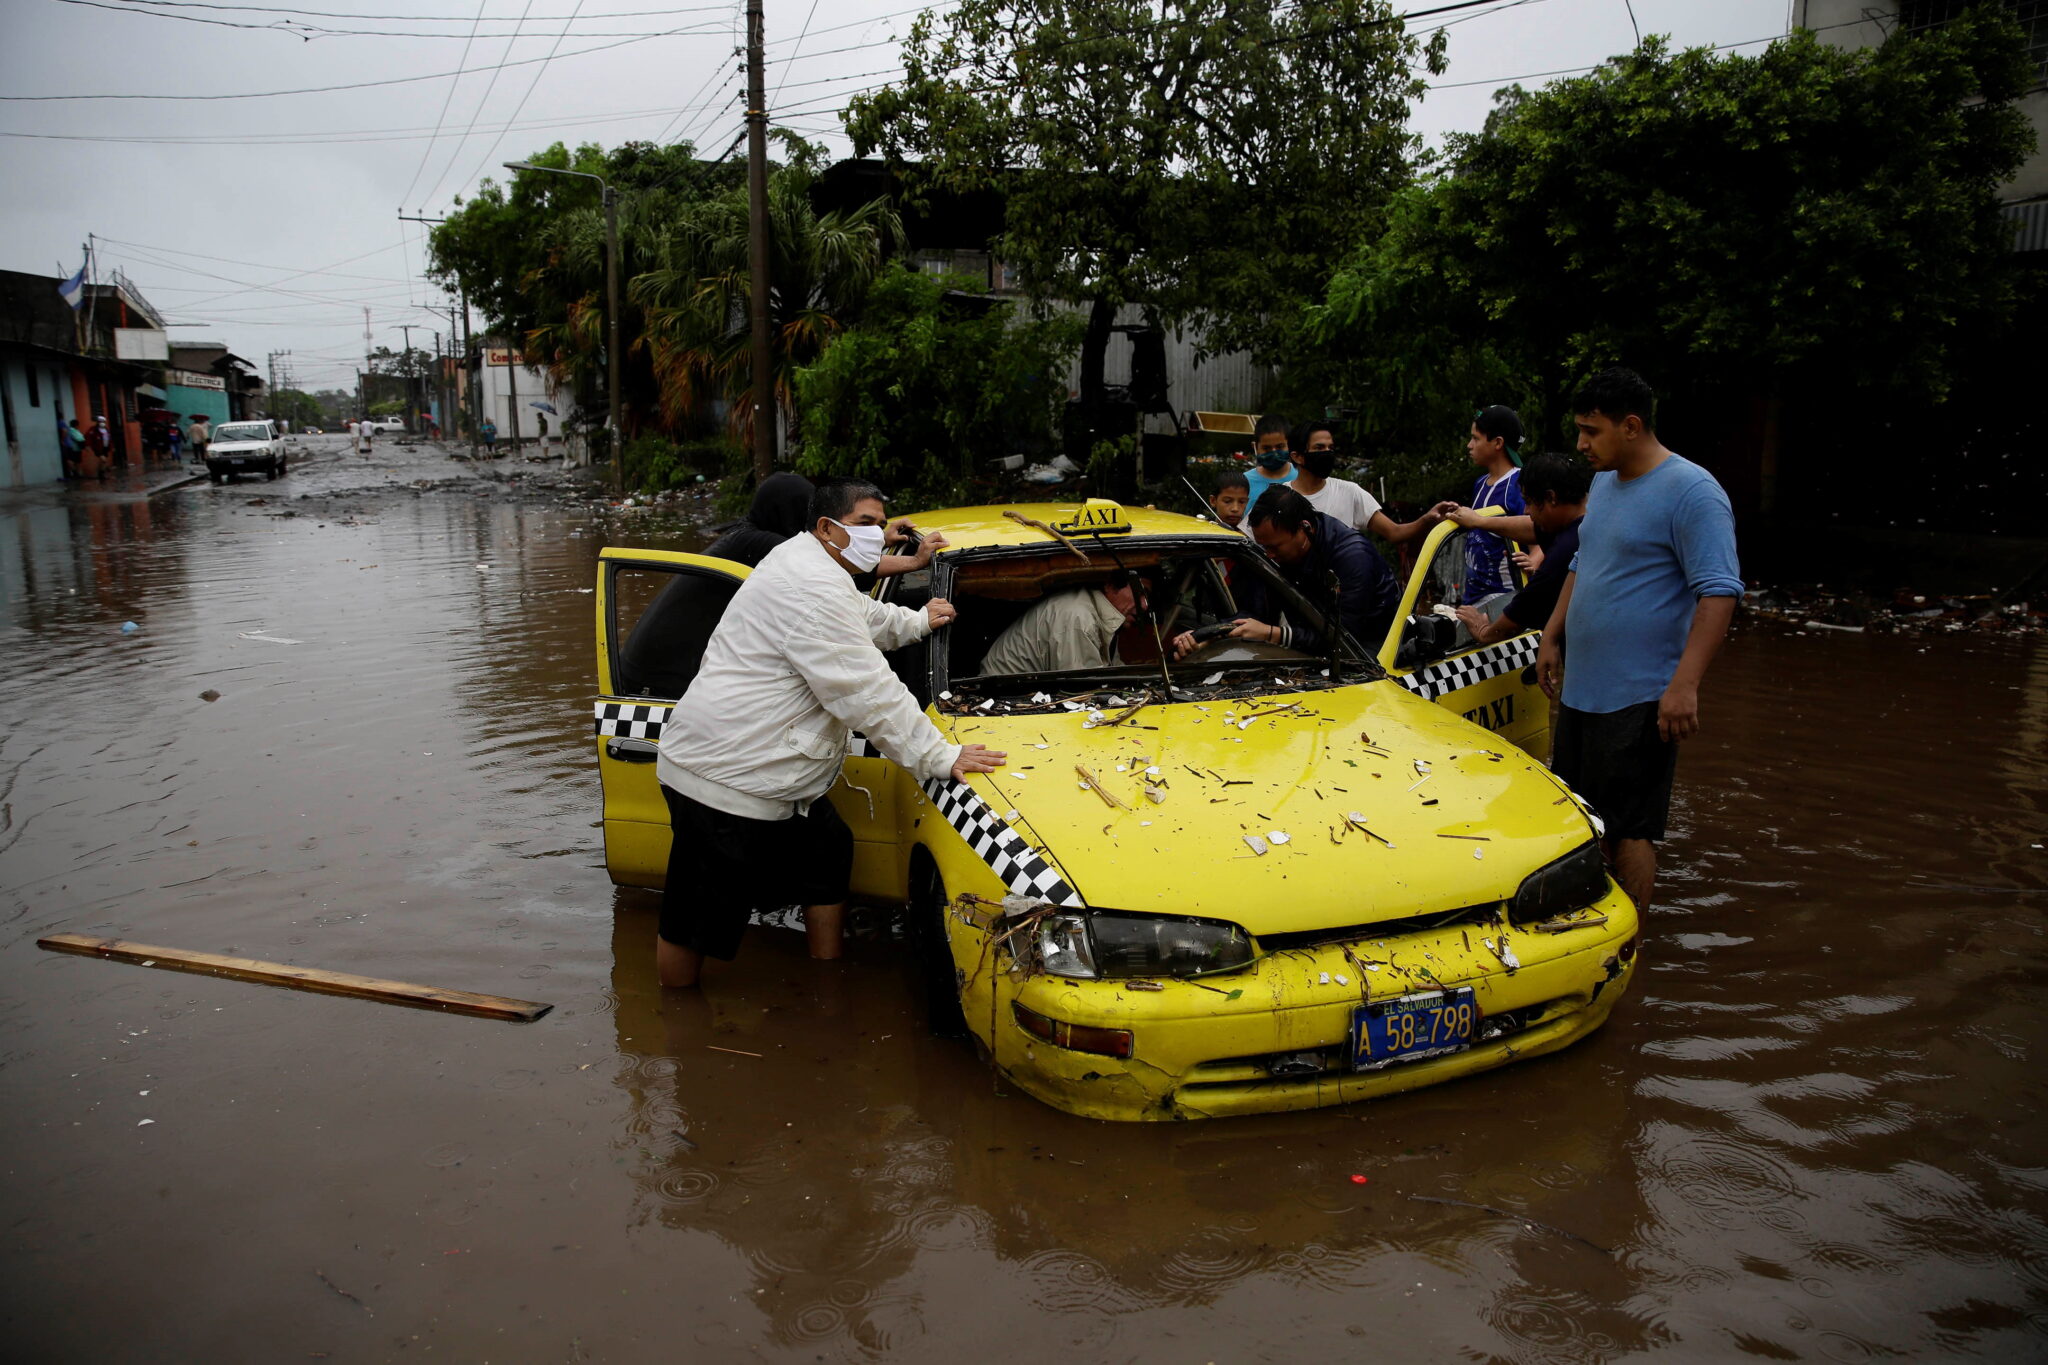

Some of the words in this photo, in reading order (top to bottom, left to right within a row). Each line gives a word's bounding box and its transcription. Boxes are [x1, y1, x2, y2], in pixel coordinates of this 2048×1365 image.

[1078, 508, 1118, 526] AXI
[1384, 1003, 1395, 1016] EL
[1397, 997, 1444, 1014] SALVADOR
[1358, 1020, 1372, 1057] A
[1386, 1013, 1415, 1052] 58
[1428, 1003, 1472, 1045] 798
